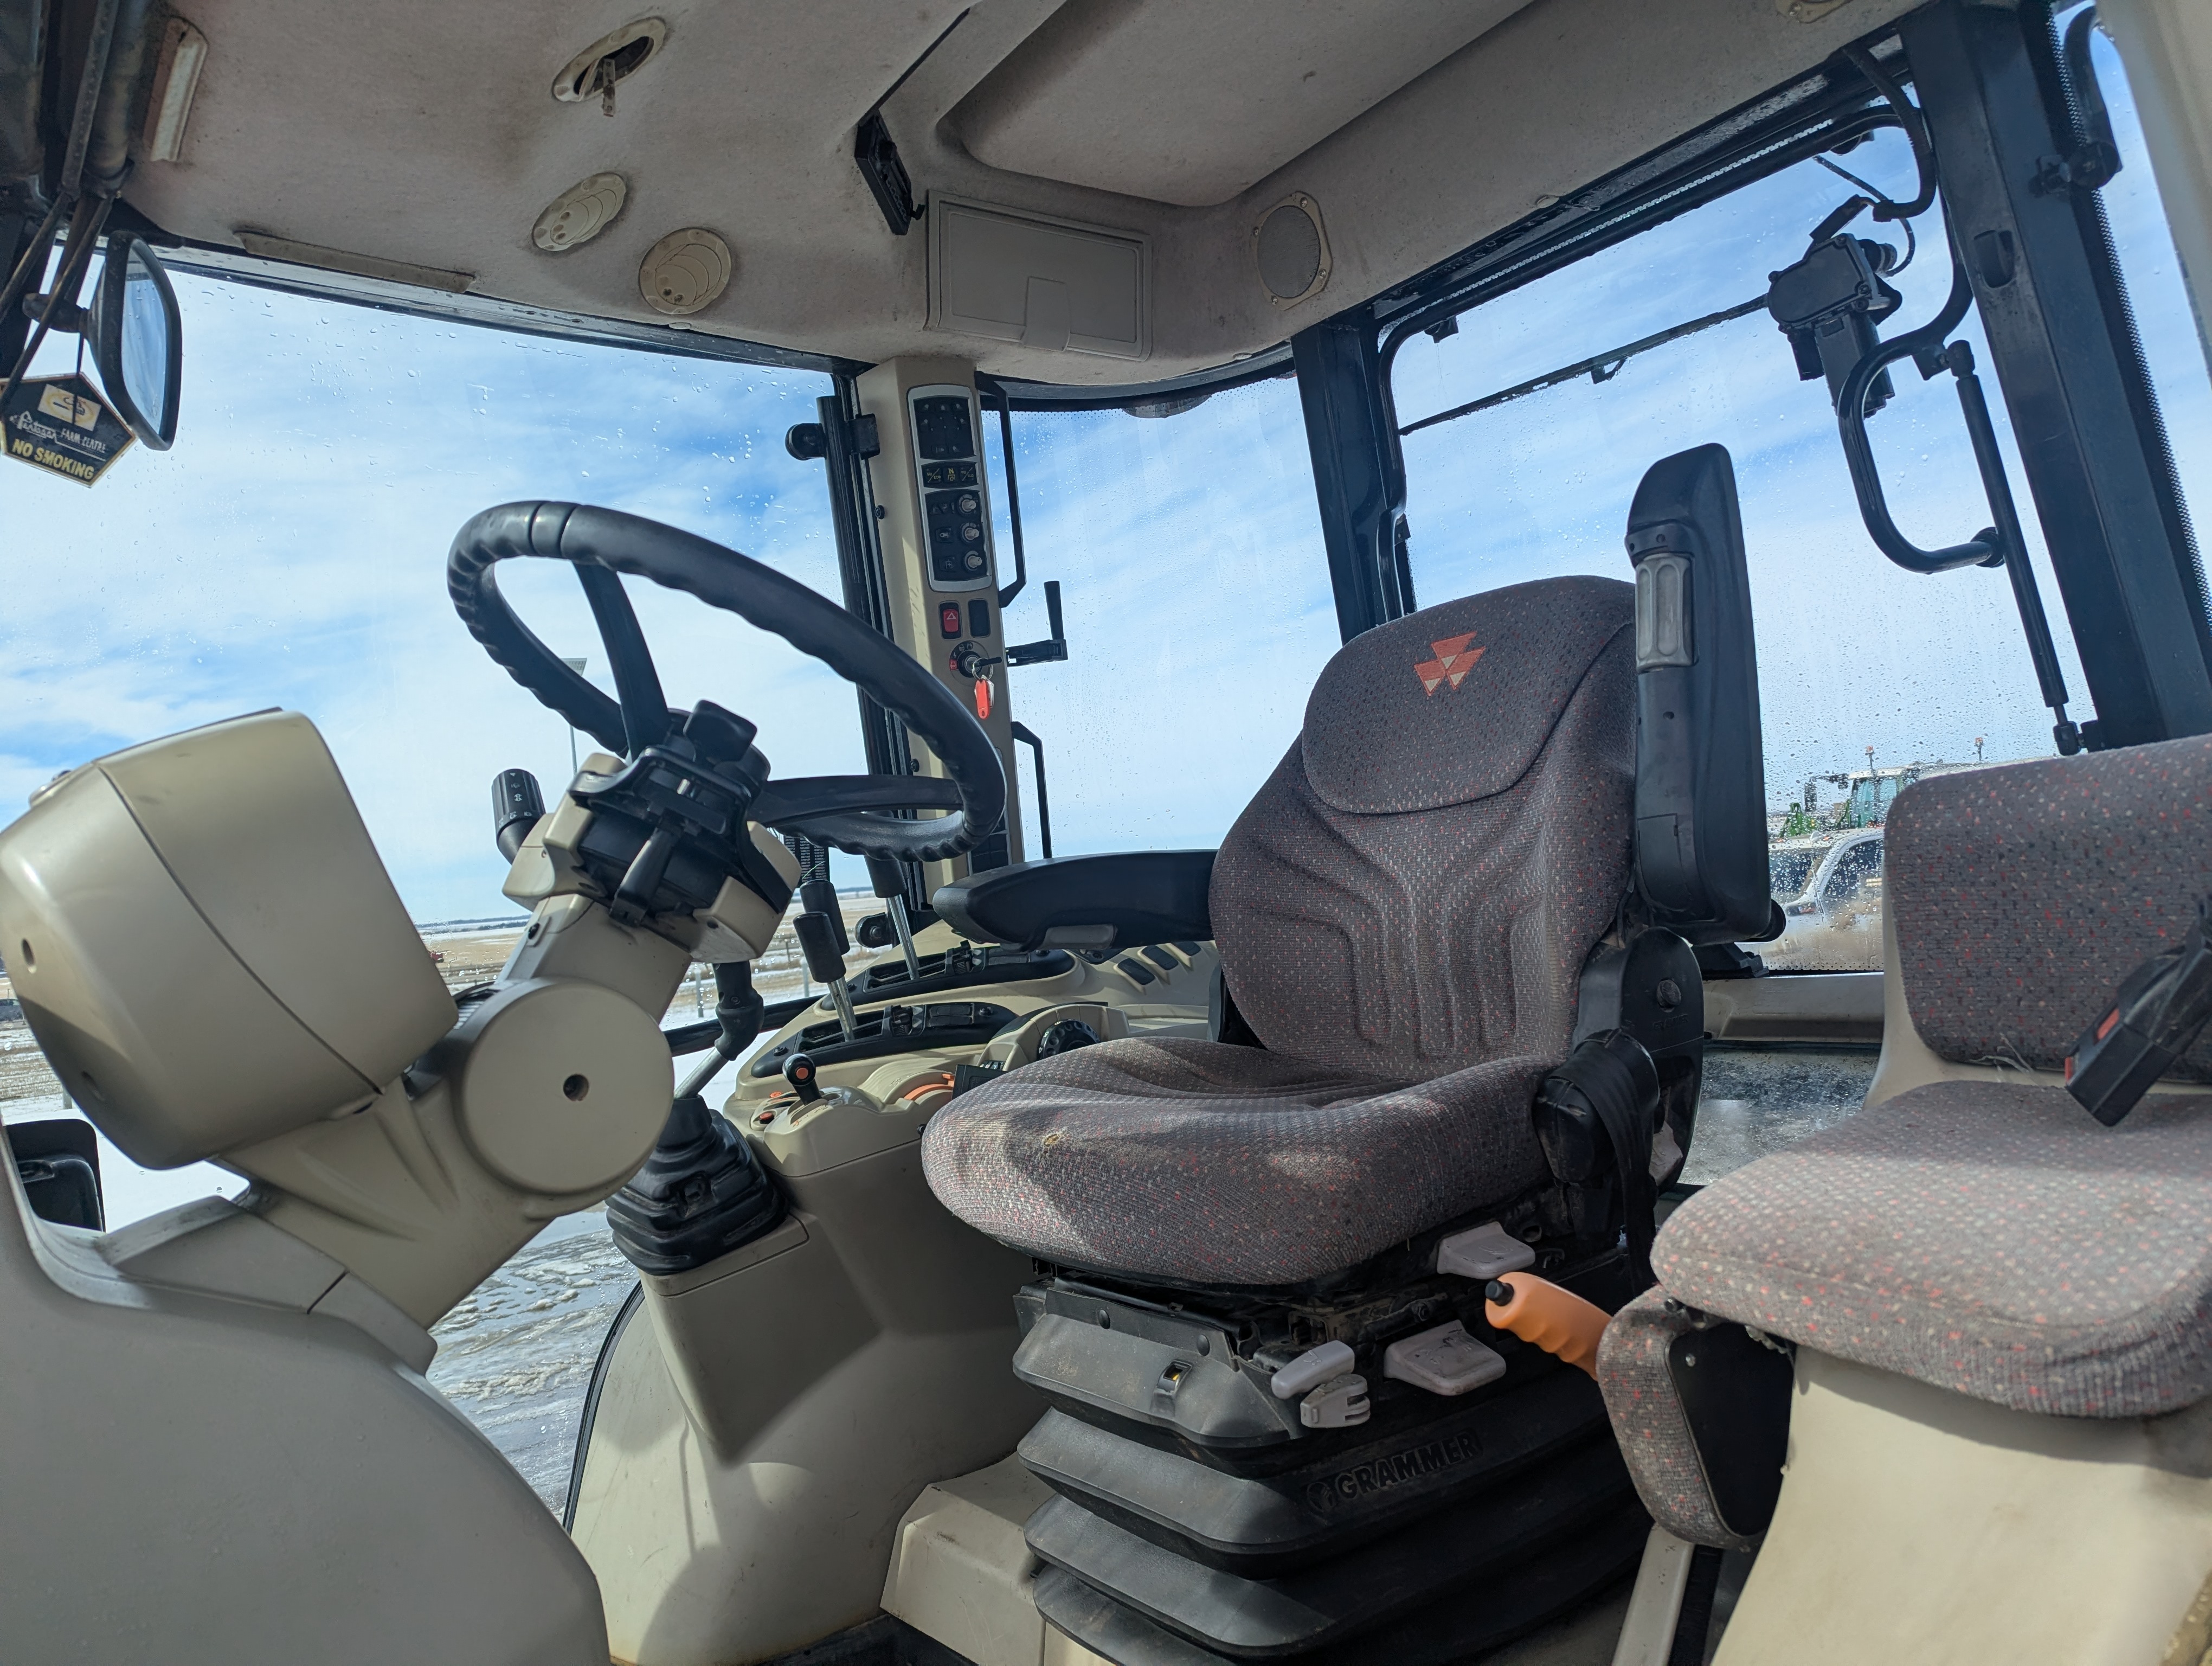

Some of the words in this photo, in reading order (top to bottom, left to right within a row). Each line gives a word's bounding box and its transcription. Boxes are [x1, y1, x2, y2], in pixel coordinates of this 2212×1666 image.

[12, 439, 34, 457] NO
[34, 447, 94, 479] SMOKING
[1335, 1432, 1478, 1499] GRAMMER
